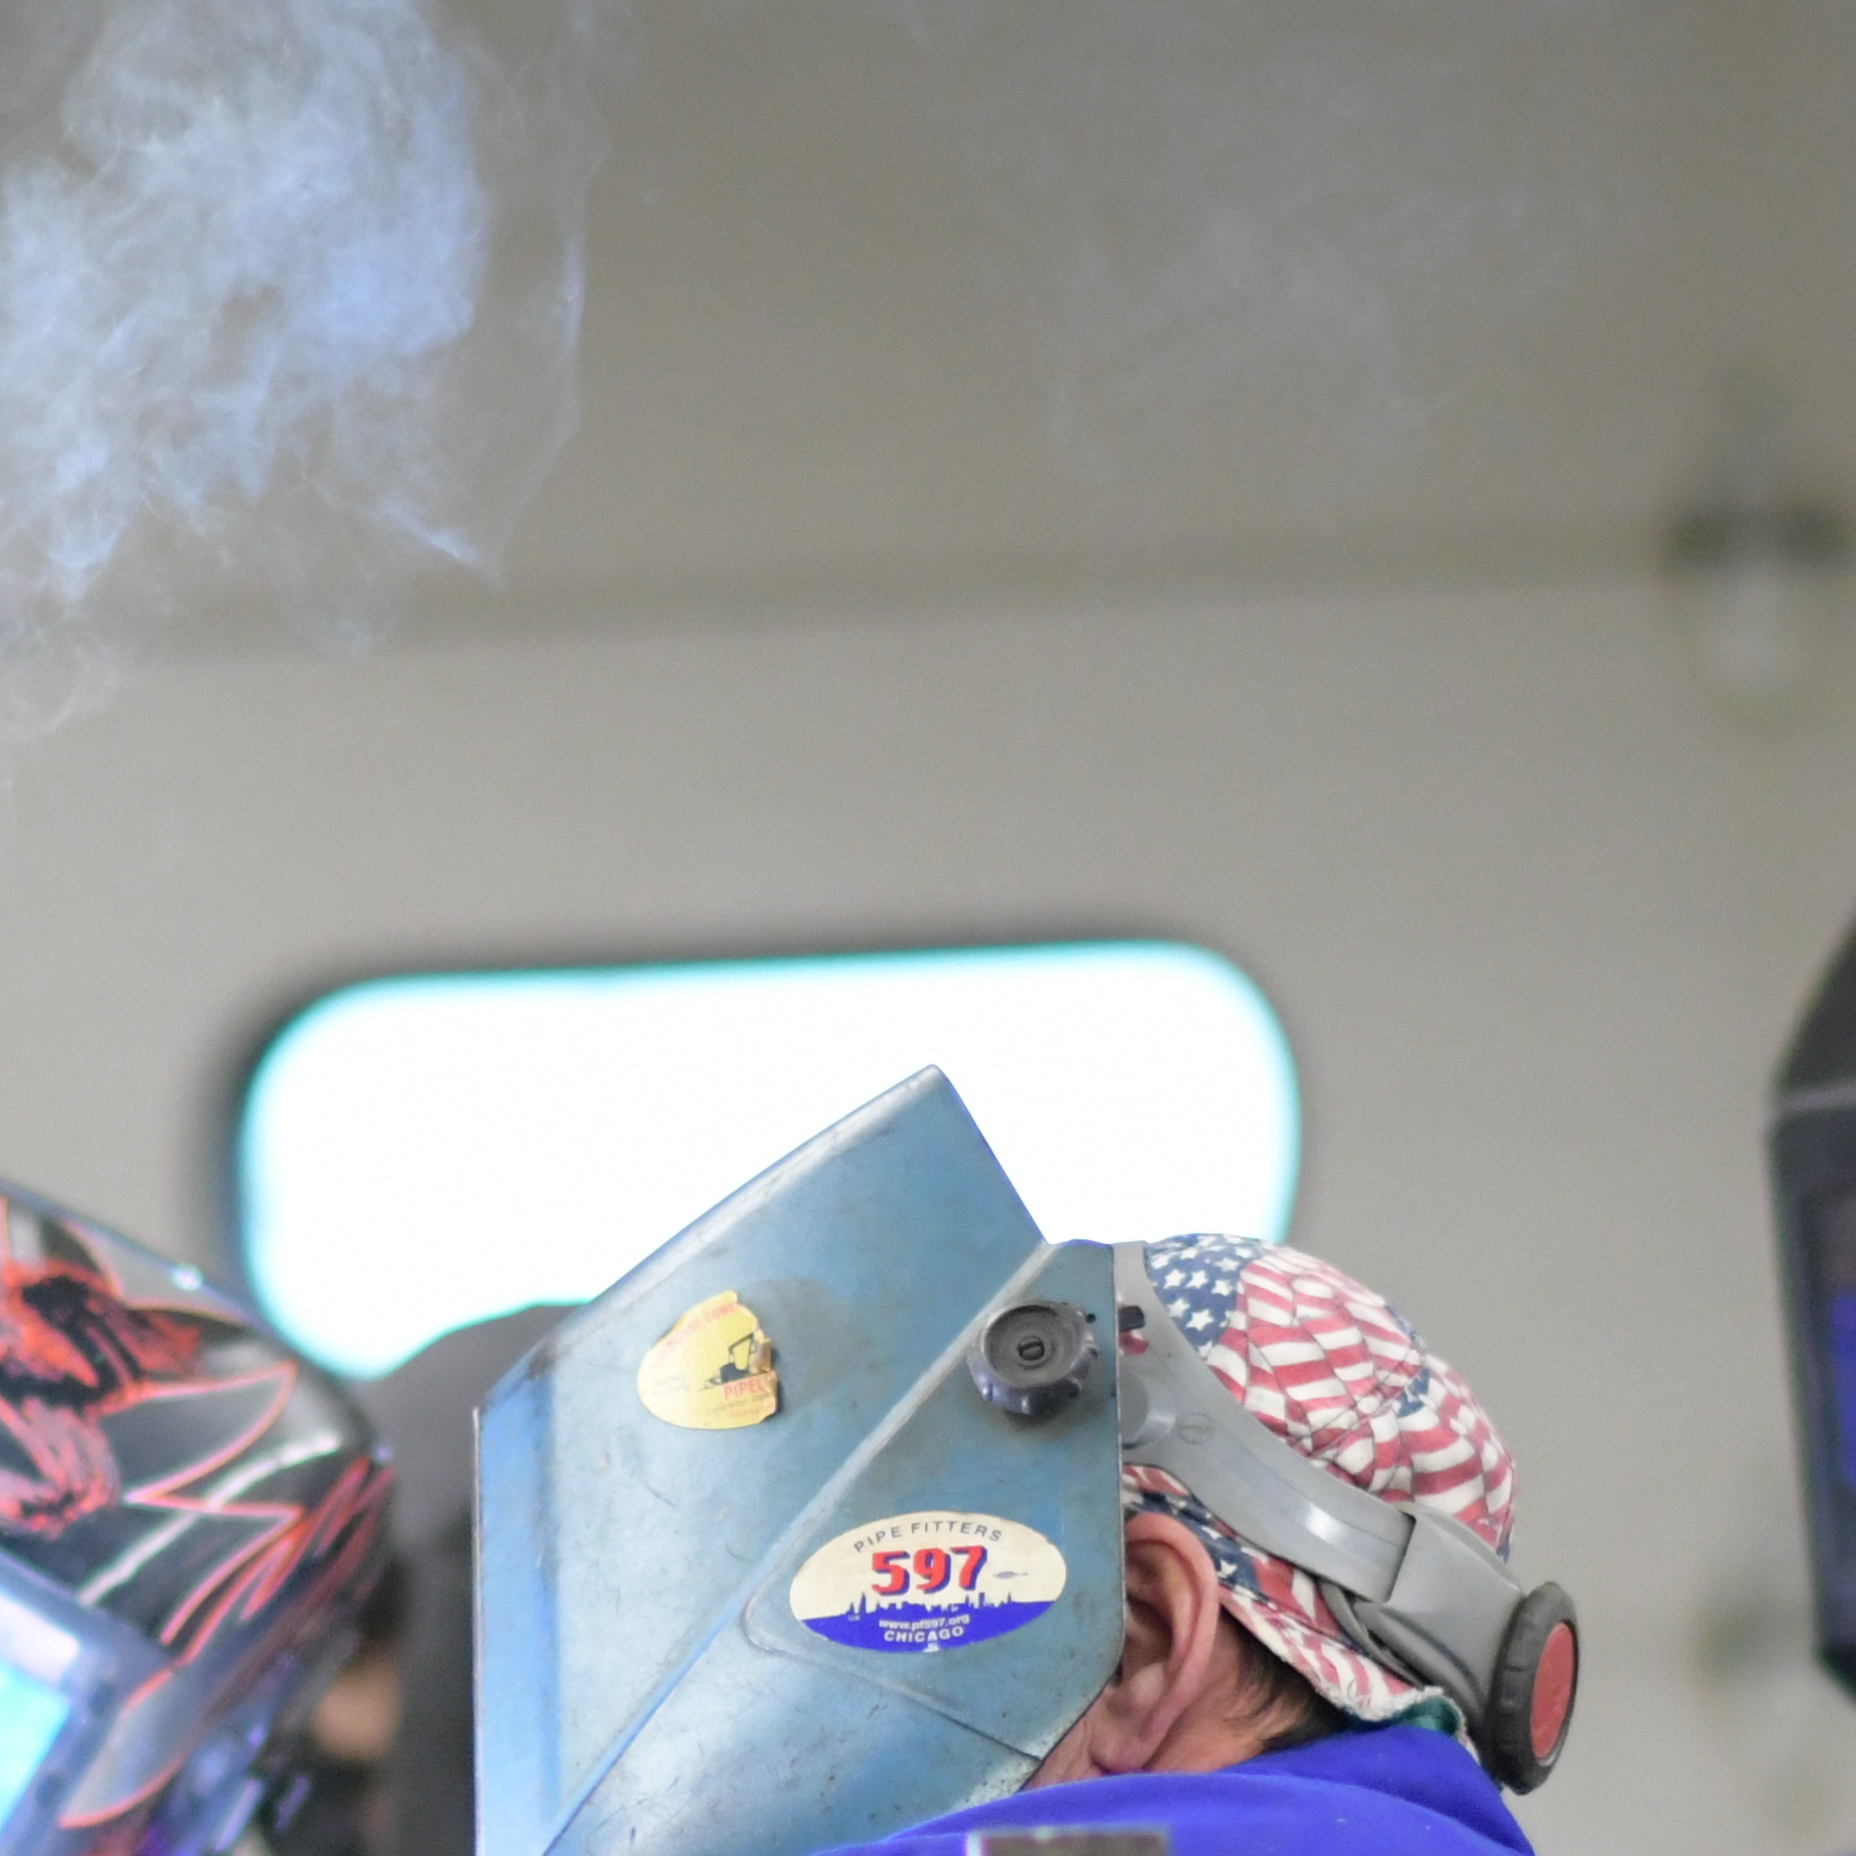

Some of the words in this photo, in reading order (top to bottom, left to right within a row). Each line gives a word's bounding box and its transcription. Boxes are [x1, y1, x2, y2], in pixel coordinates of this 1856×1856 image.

[854, 1527, 901, 1552] PIPE
[912, 1521, 1002, 1542] FITTERS
[871, 1545, 988, 1596] 597
[879, 1614, 970, 1630] www.pf597.org
[884, 1626, 964, 1642] CHICAGO
